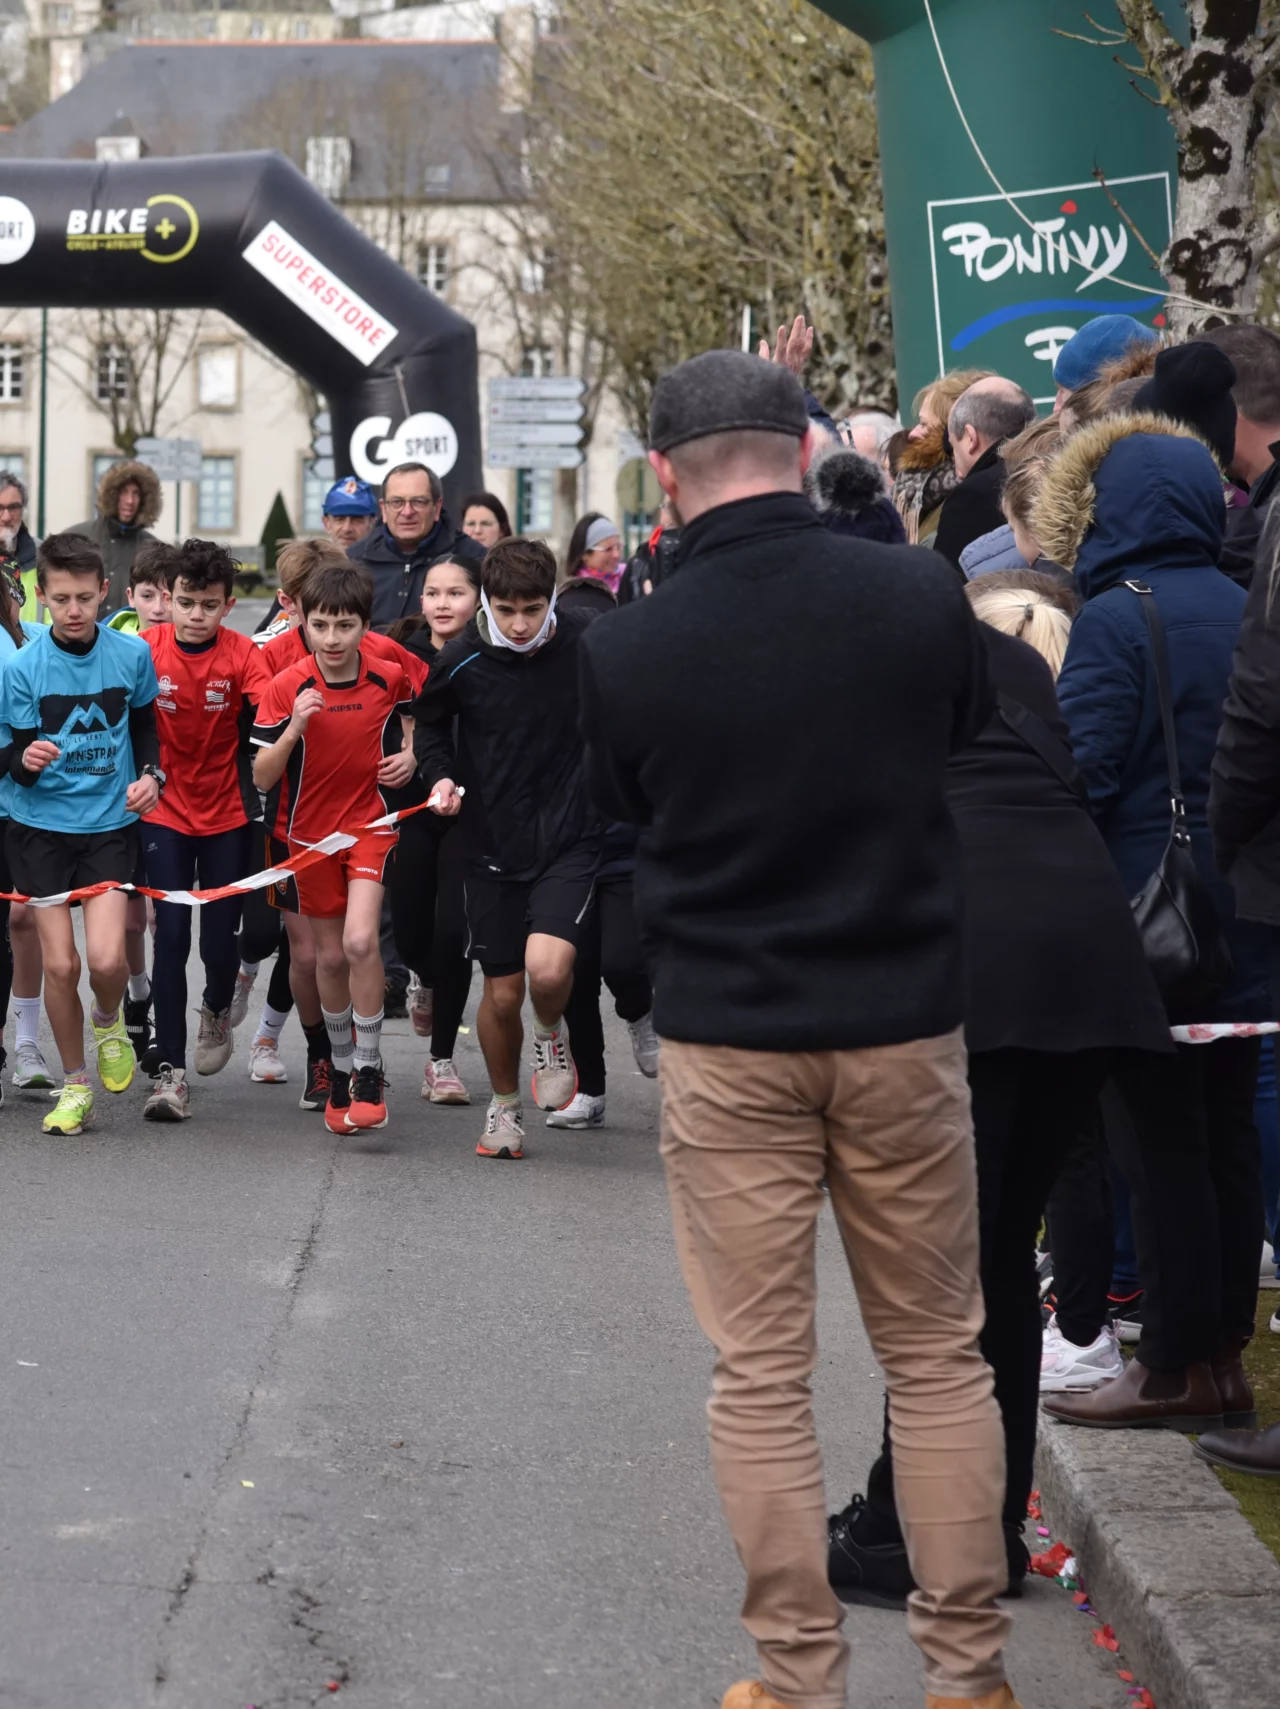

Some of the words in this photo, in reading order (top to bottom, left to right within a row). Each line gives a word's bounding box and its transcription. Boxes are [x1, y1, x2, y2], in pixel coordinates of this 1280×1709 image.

[66, 208, 149, 235] BIKE
[262, 233, 387, 346] SUPERSTORE
[404, 436, 449, 456] SPORT
